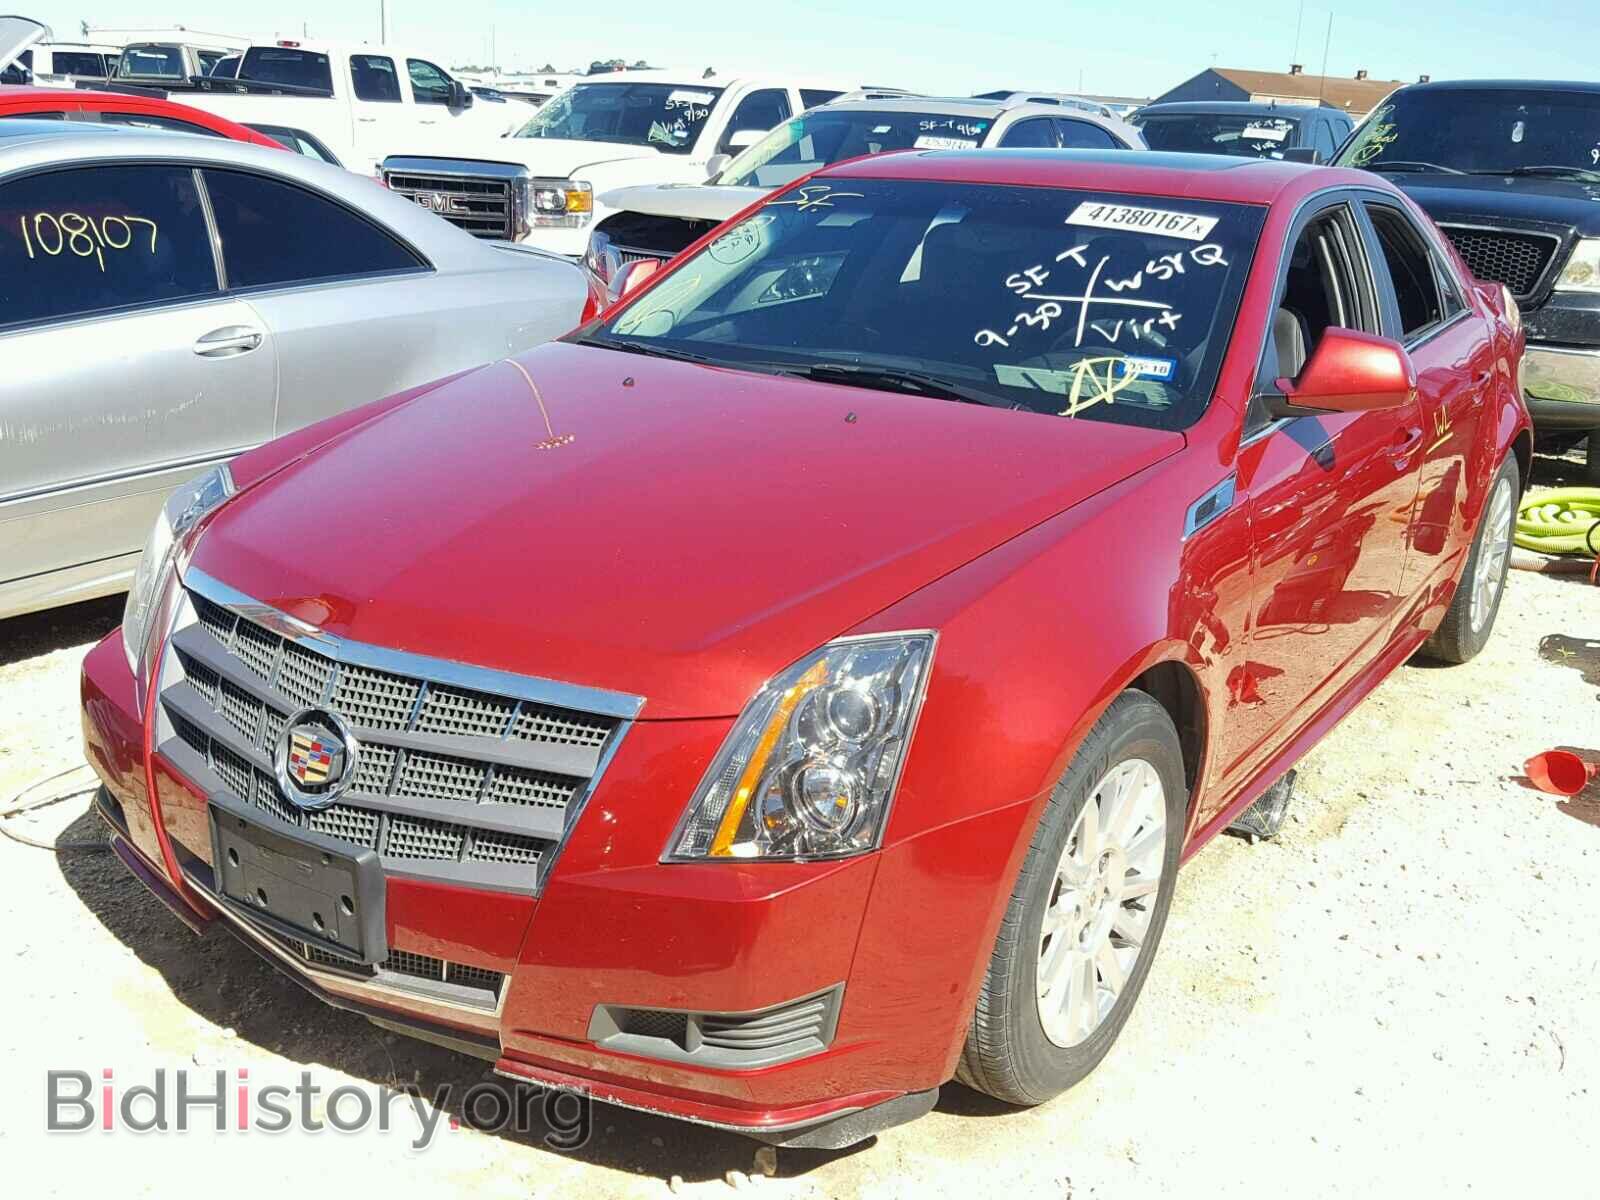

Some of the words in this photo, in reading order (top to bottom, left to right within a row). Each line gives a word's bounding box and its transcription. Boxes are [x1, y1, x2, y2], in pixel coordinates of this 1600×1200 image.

[414, 192, 469, 216] GMC
[1087, 205, 1197, 232] 41380167
[1005, 264, 1050, 294] SF
[1055, 244, 1090, 268] T
